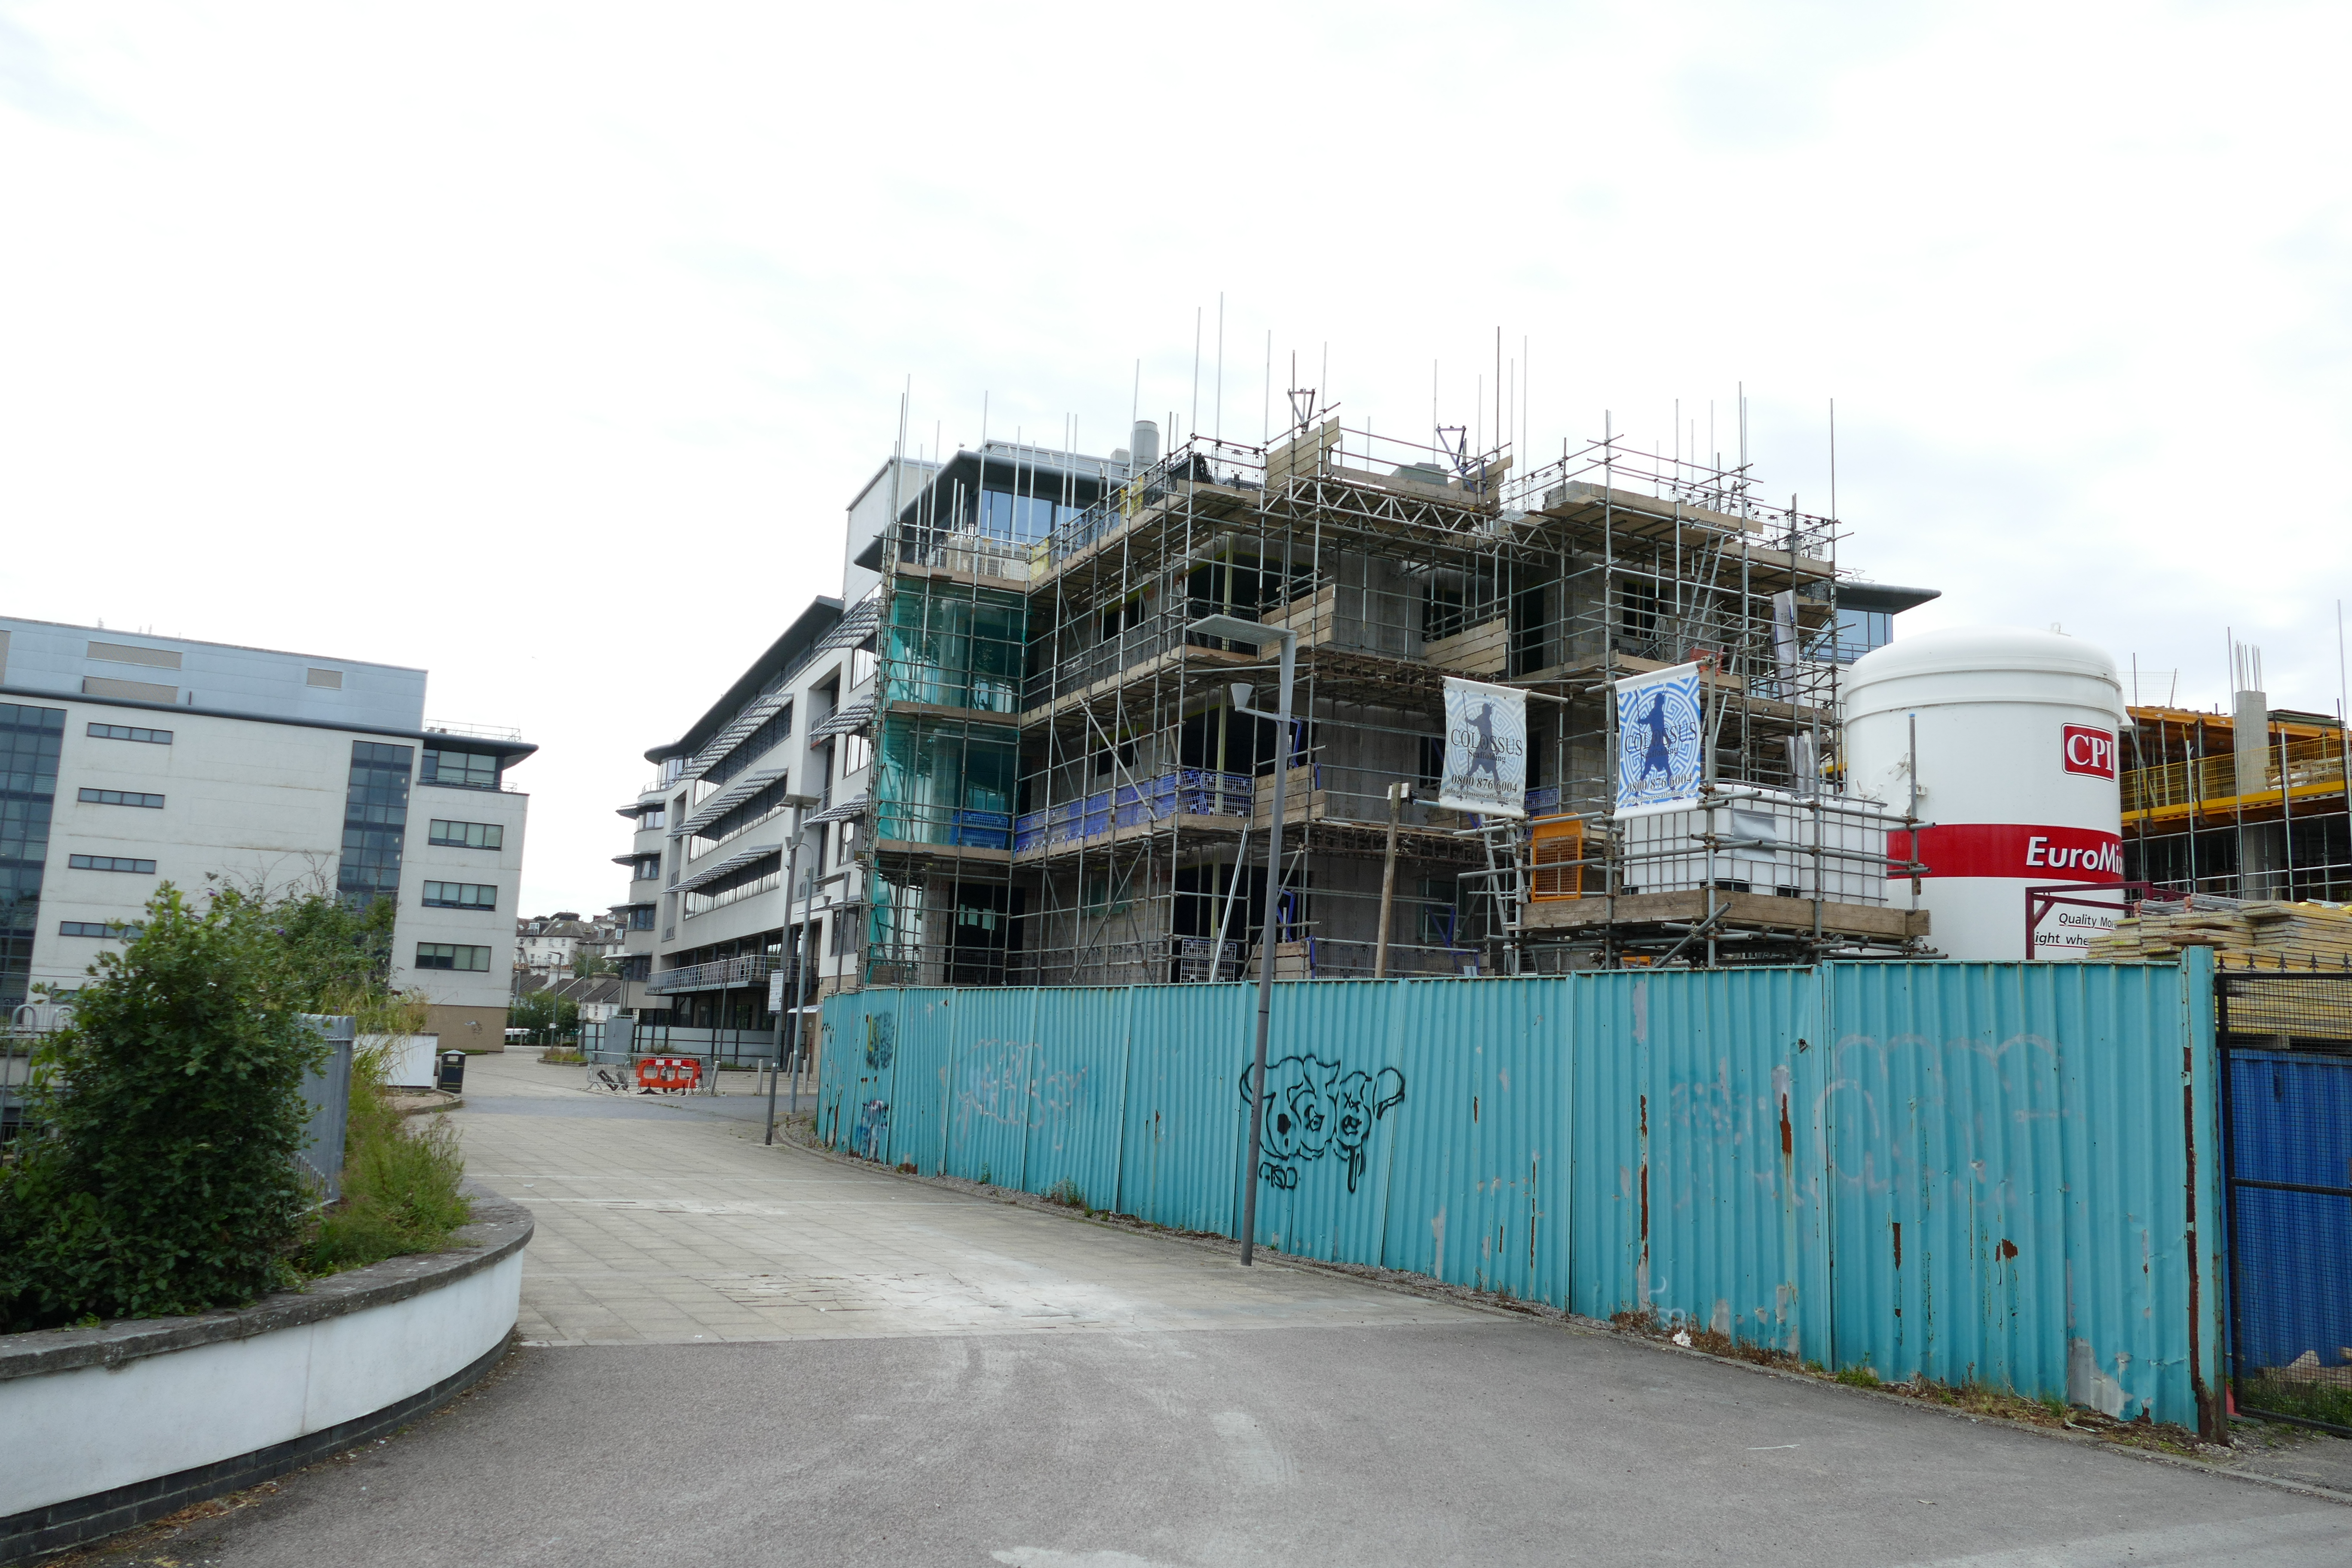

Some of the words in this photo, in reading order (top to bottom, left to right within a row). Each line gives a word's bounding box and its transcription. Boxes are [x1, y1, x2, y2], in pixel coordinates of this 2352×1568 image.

[1451, 729, 1522, 756] COLOSSUS
[1625, 722, 1697, 753] COLOSSUS
[1468, 749, 1506, 764] Scaffolding
[1641, 747, 1678, 760] Scaffolding
[2067, 734, 2113, 771] CPI
[1451, 774, 1474, 787] 0800
[1476, 778, 1493, 790] 876
[1496, 781, 1517, 793] 6004
[1627, 779, 1647, 793] 0800
[1650, 776, 1666, 790] 876
[1669, 772, 1692, 787] 6004
[2026, 836, 2124, 876] EuroMix
[2059, 913, 2097, 928] Quality
[2100, 916, 2116, 928] Mor
[2035, 932, 2060, 945] ight
[2066, 934, 2089, 945] whe
